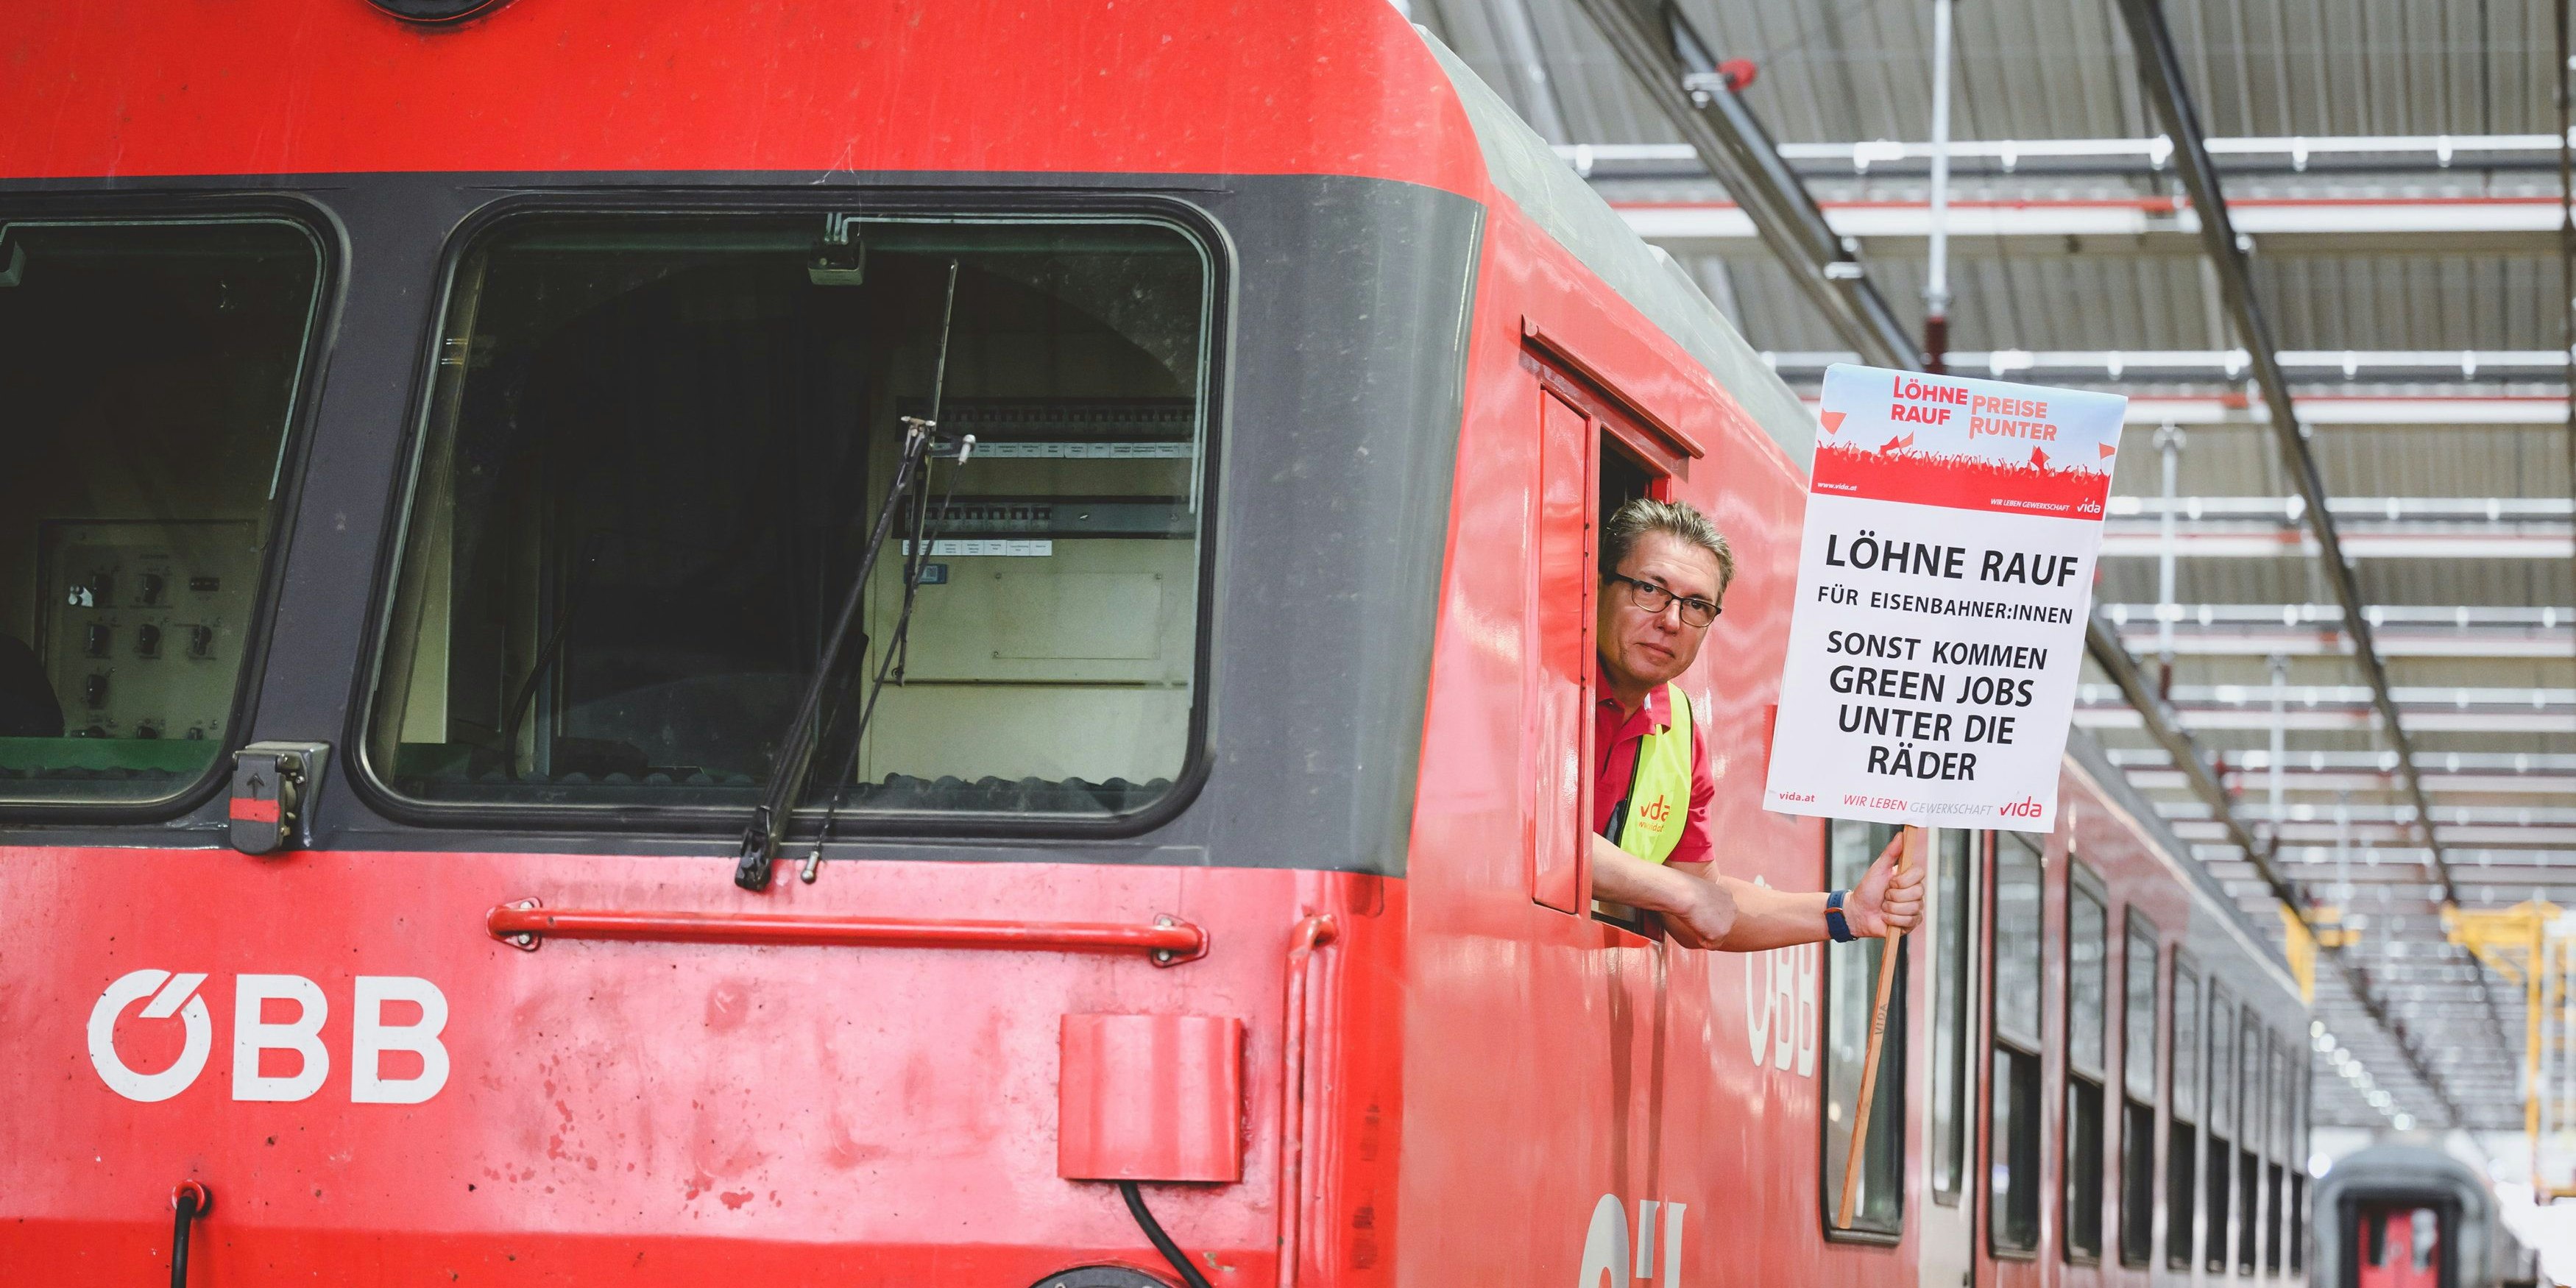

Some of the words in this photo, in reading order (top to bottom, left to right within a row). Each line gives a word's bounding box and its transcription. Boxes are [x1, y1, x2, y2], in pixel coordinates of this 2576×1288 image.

[1892, 375, 1969, 406] LÖHNE
[1890, 404, 1951, 426] RAUF
[1971, 394, 2048, 420] PREISE
[1969, 417, 2058, 442] RUNTER
[1817, 482, 1858, 492] www.vida.at
[1990, 498, 2003, 506] WIR
[2003, 500, 2022, 508] LEBEN
[2023, 501, 2070, 512] GEWERKSCHAFT
[2076, 497, 2101, 514] vida
[1826, 529, 1966, 579] LÖHNE
[1981, 550, 2078, 587] RAUF
[1818, 584, 1859, 606] FÜR
[1870, 591, 2073, 625] EISENBAHNER:INNEN
[1827, 630, 1921, 660] SONST
[1932, 641, 2048, 670] KOMMEN
[1830, 665, 1945, 703] GREEN
[1956, 676, 2034, 707] JOBS
[1839, 704, 1952, 742] UNTER
[1964, 715, 2015, 745] DIE
[1867, 742, 1977, 781] RÄDER
[1641, 794, 1671, 822] vda
[1779, 791, 1816, 803] vida.at
[1843, 794, 1867, 807] WIR
[1869, 797, 1907, 811] LEBEN
[1909, 802, 1994, 816] GEWERKSCHAFT
[1999, 796, 2042, 818] vida
[1874, 1002, 1887, 1036] VIDA
[87, 969, 450, 1104] ÖBB
